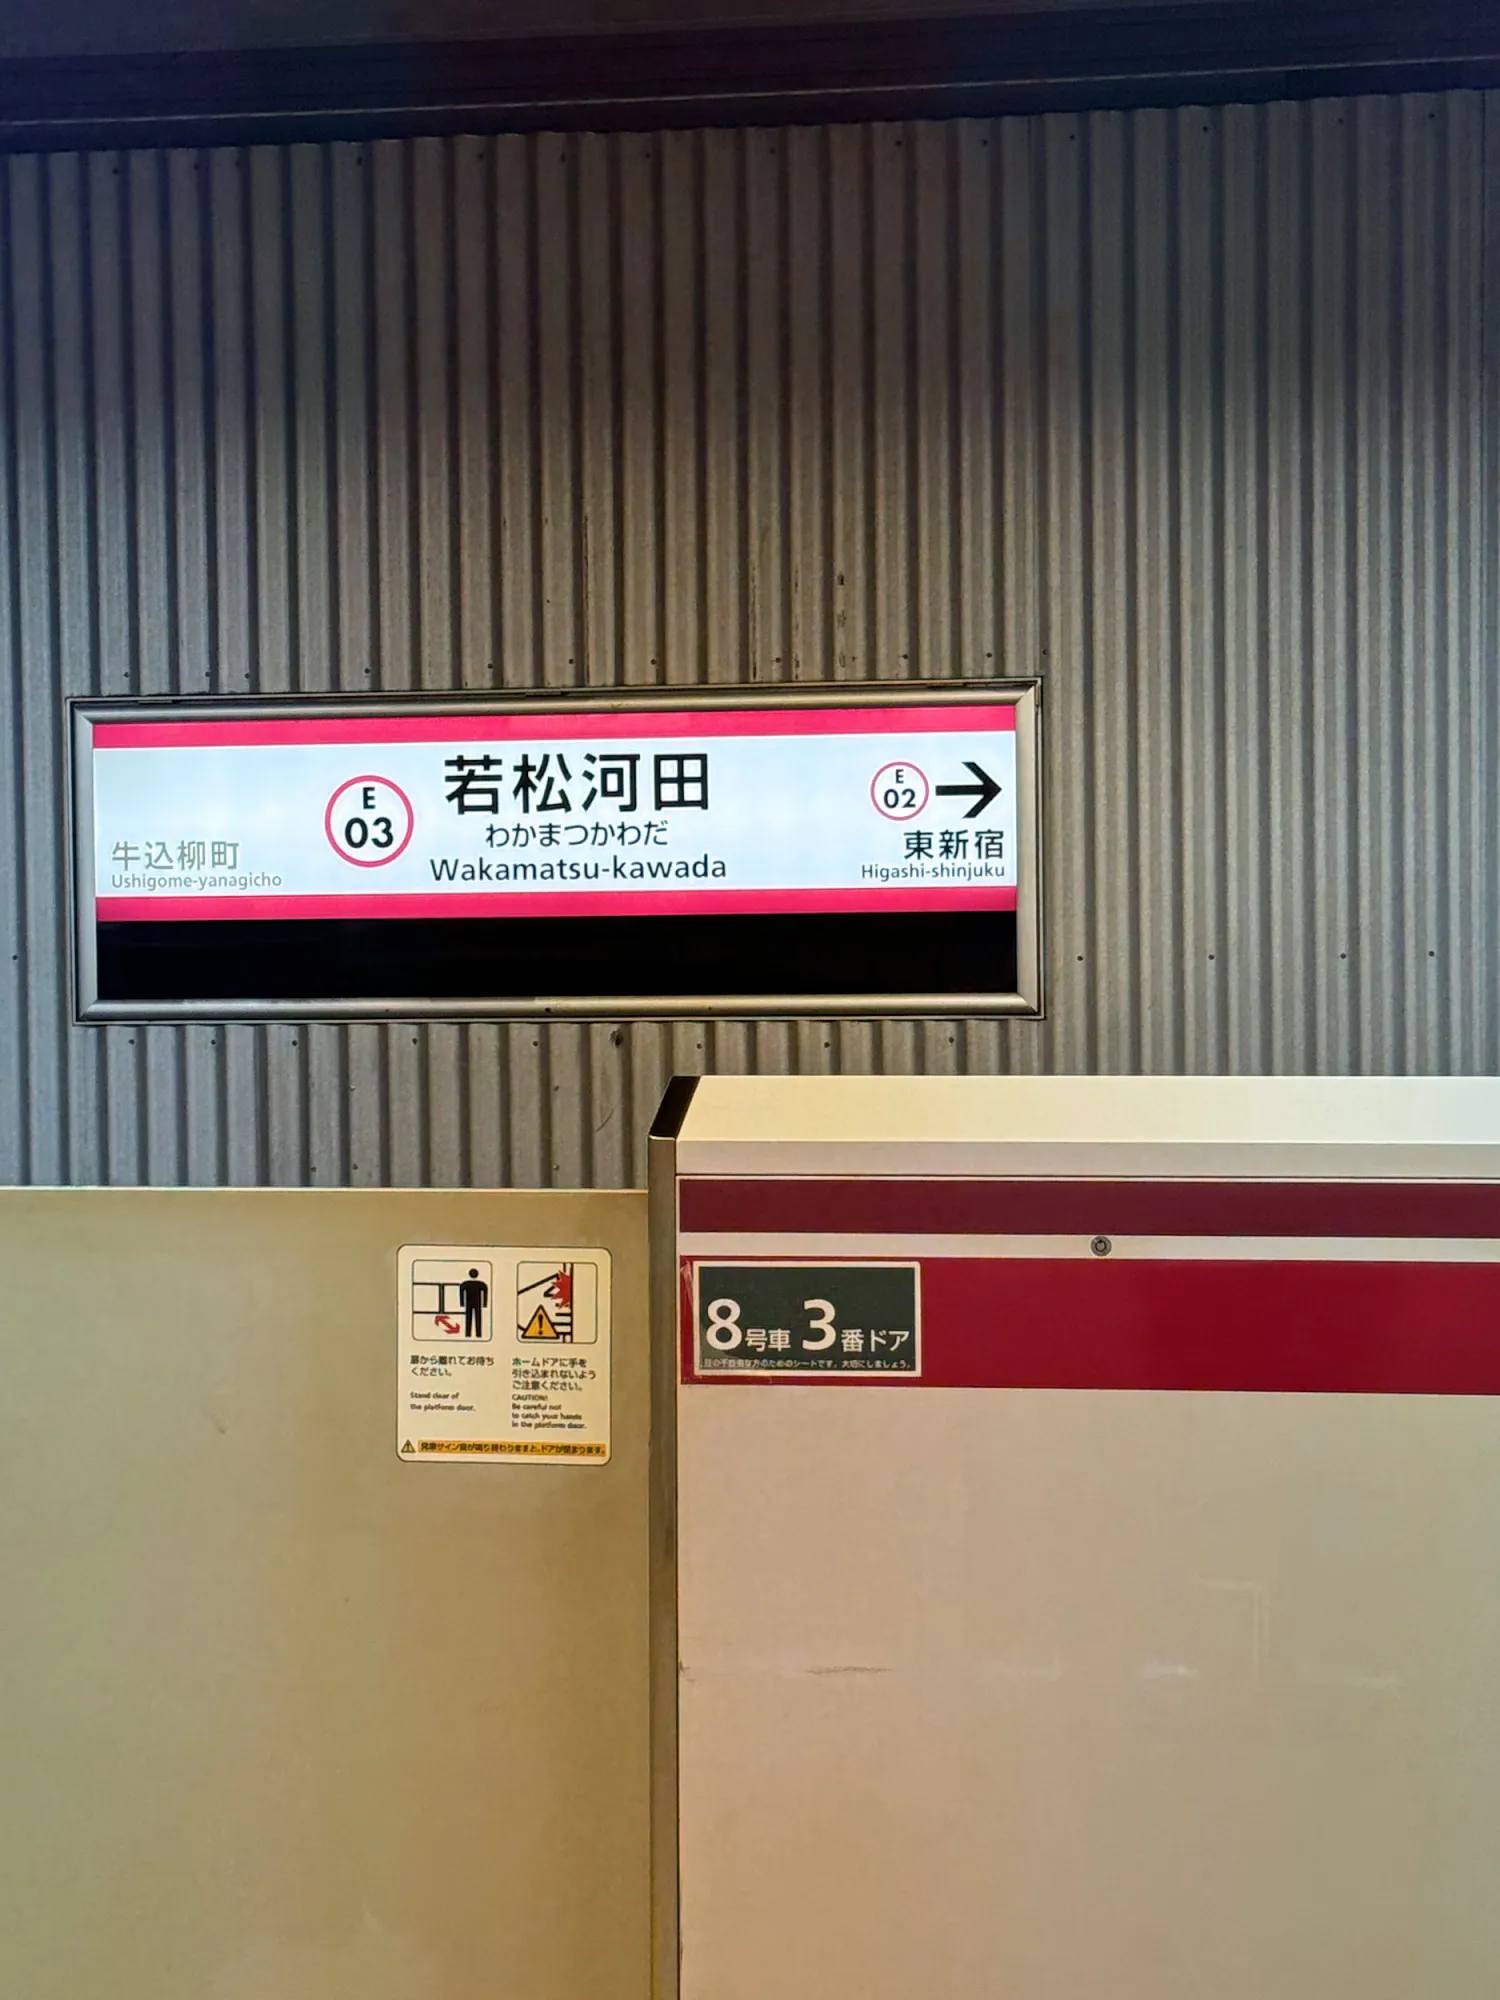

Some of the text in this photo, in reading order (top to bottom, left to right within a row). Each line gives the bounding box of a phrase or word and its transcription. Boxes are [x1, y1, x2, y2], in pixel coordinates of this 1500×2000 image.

[444, 753, 709, 815] 若松河田
[896, 769, 905, 784] E
[363, 787, 376, 810] E
[884, 788, 917, 809] 02
[345, 816, 394, 849] 03
[485, 819, 669, 849] わかまつかわだ
[903, 829, 1004, 860] 東新宿
[111, 840, 240, 872] 牛込柳町
[430, 853, 727, 882] Wakamatsu-kawada
[861, 863, 1005, 882] Higashi-shinjuku
[111, 872, 283, 892] Ushigome-yanagicho
[411, 1367, 453, 1377] ください。
[512, 1357, 588, 1368] ホームドアに手を
[512, 1368, 597, 1380] 引き込まれないよう
